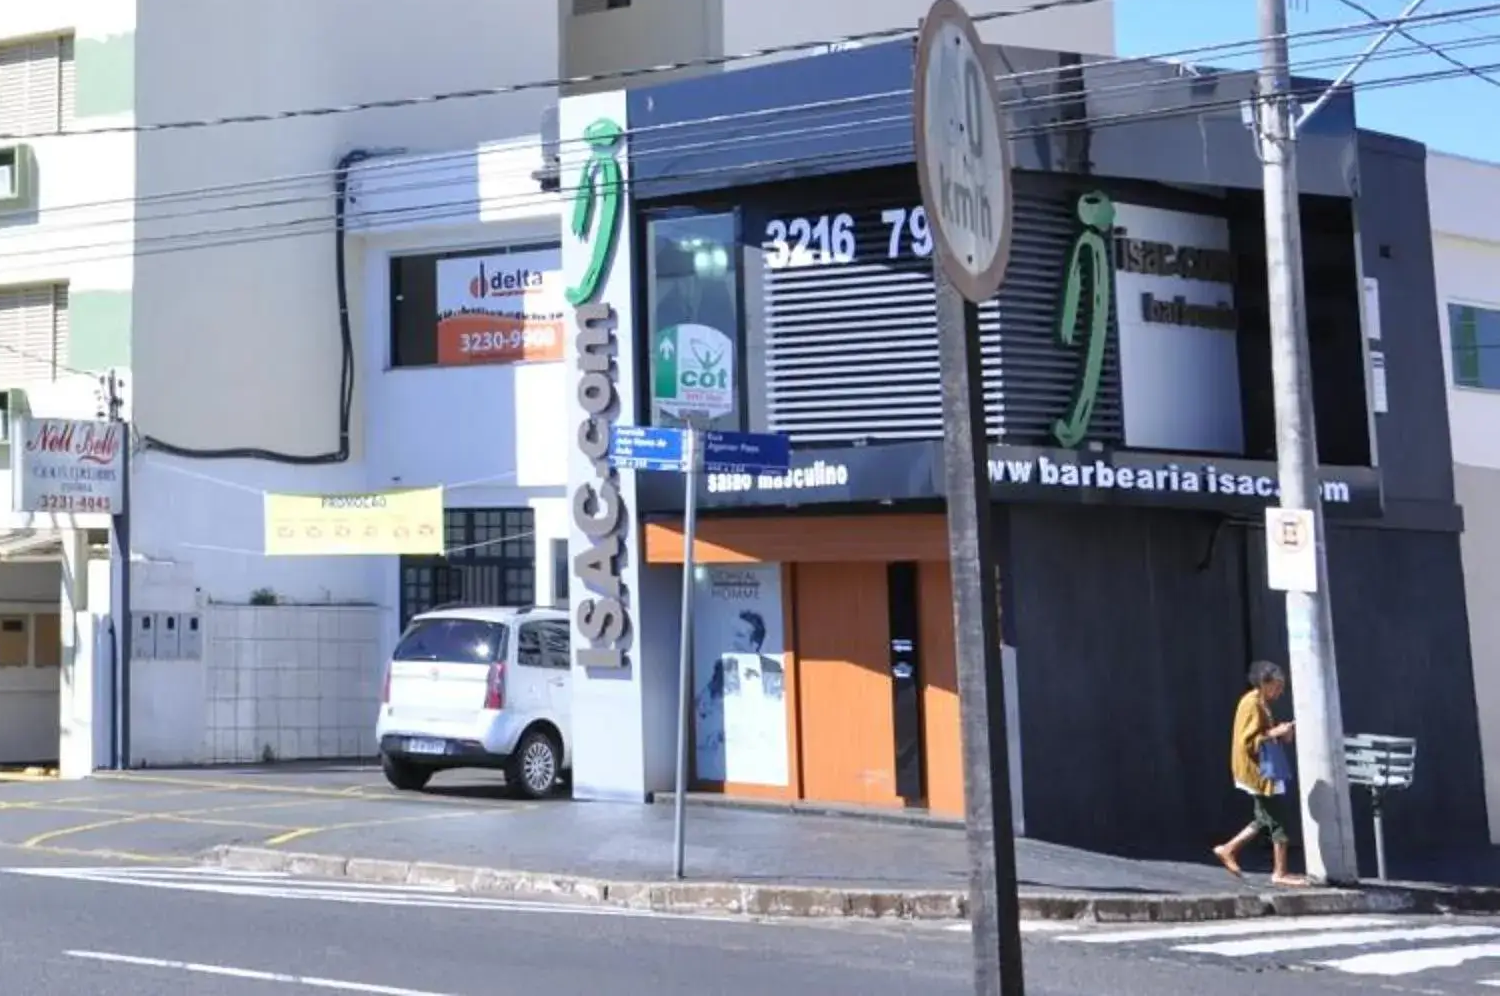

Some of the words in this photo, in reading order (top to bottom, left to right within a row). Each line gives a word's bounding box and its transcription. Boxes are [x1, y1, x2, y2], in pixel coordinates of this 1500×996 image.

[762, 212, 856, 268] 3216
[491, 268, 543, 291] delta
[680, 368, 727, 389] cot
[757, 460, 848, 490] masculino
[1039, 456, 1200, 492] barbearia
